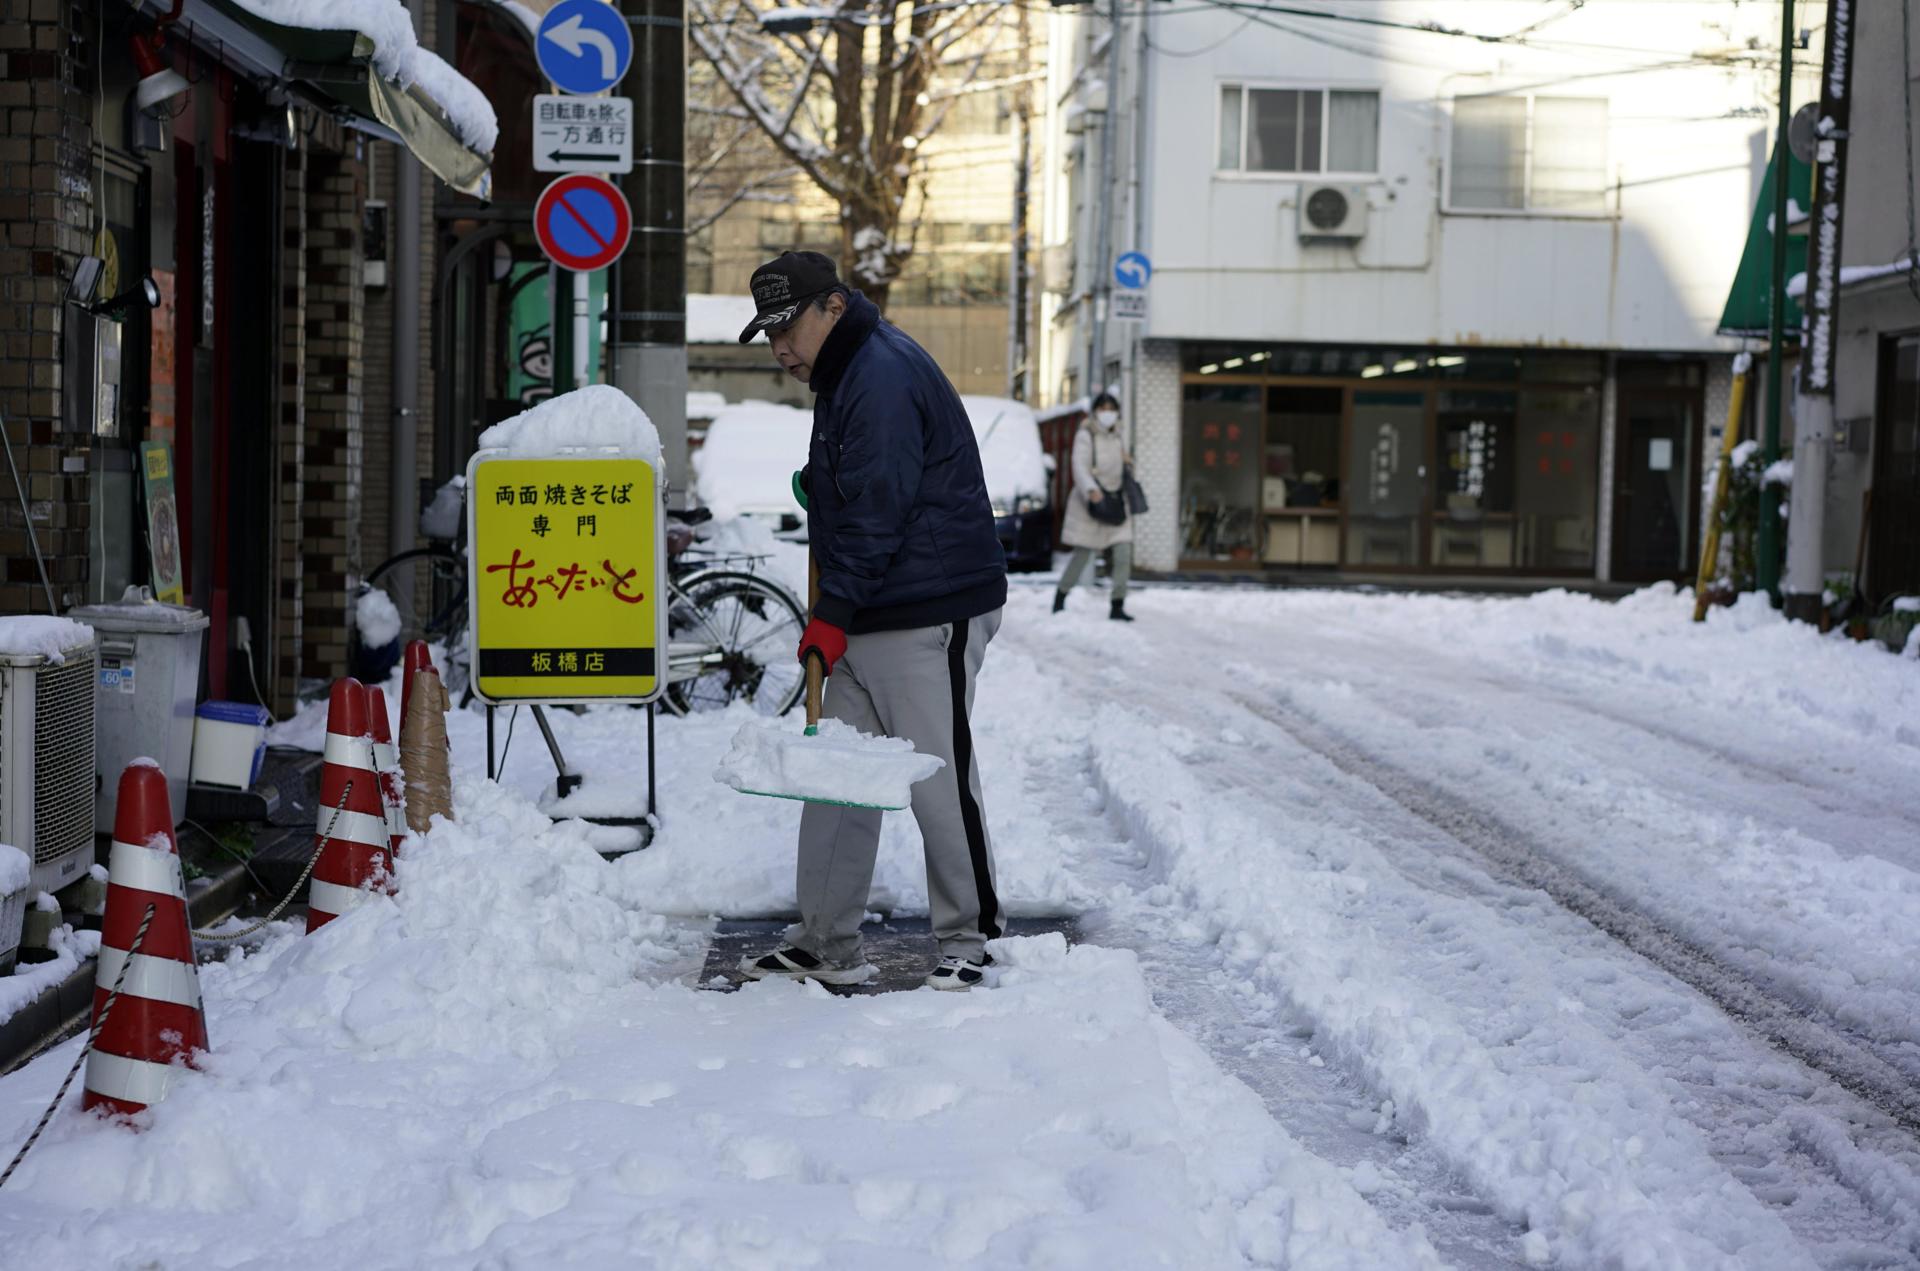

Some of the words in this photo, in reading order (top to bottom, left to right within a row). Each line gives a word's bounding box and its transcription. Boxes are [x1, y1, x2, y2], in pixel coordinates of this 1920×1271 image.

[540, 103, 626, 122] 自転車を除く
[541, 124, 626, 145] 一方通行
[495, 483, 633, 506] 両面焼きそば
[531, 514, 596, 537] 専門
[486, 548, 644, 608] あぺたいと
[531, 652, 605, 673] 板橋店
[105, 671, 119, 684] 60
